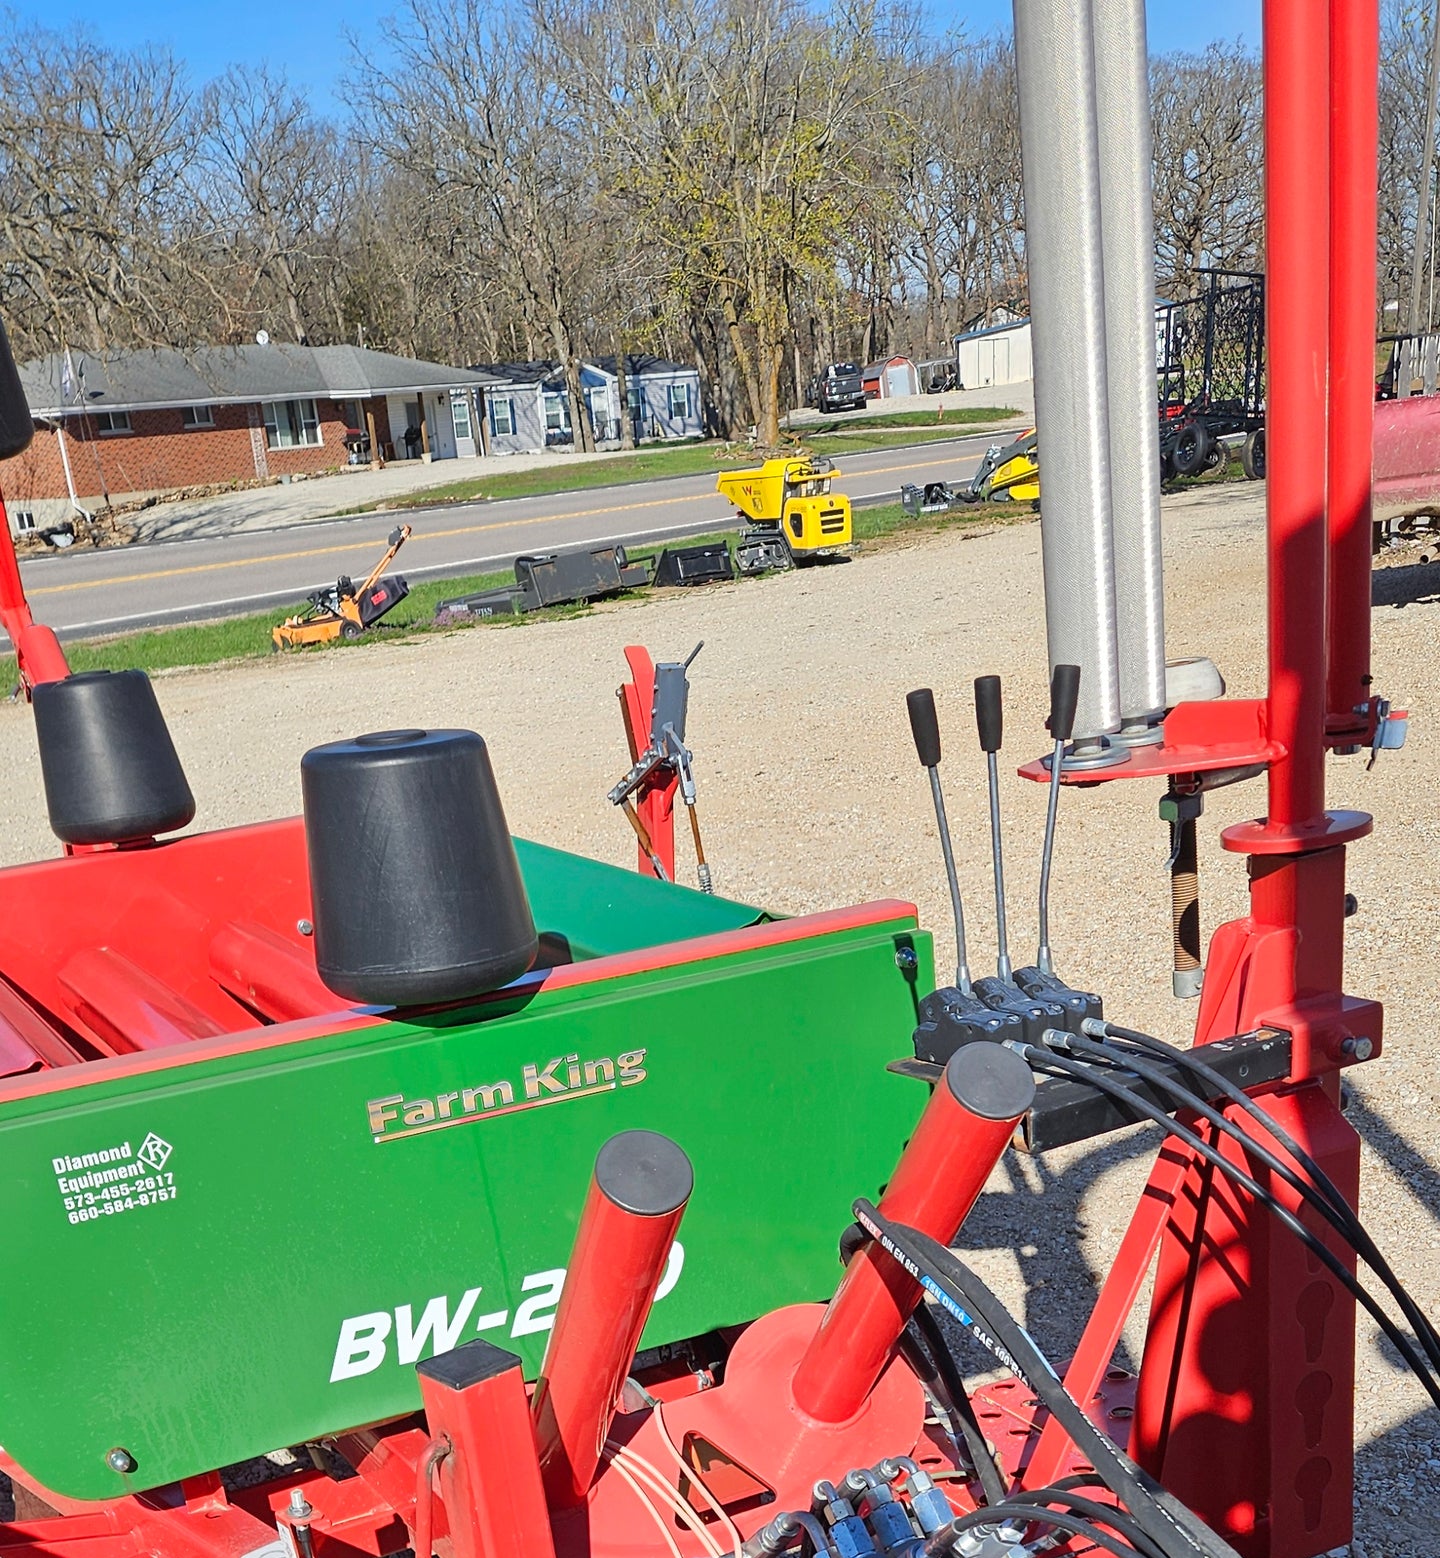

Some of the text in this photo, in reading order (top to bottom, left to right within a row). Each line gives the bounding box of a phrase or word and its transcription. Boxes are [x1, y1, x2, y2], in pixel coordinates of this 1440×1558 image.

[366, 1048, 648, 1134] Farm King
[52, 1141, 132, 1175] Diamond
[57, 1160, 146, 1194] Equipment
[63, 1172, 173, 1211] 573-455-2617
[68, 1186, 177, 1225] 660-584-8757
[329, 1240, 685, 1383] BW-2
[881, 1237, 895, 1252] DIN
[893, 1248, 906, 1263] EN
[925, 1279, 942, 1298] 1SN
[941, 1296, 965, 1321] DN10
[972, 1326, 994, 1350] SAE
